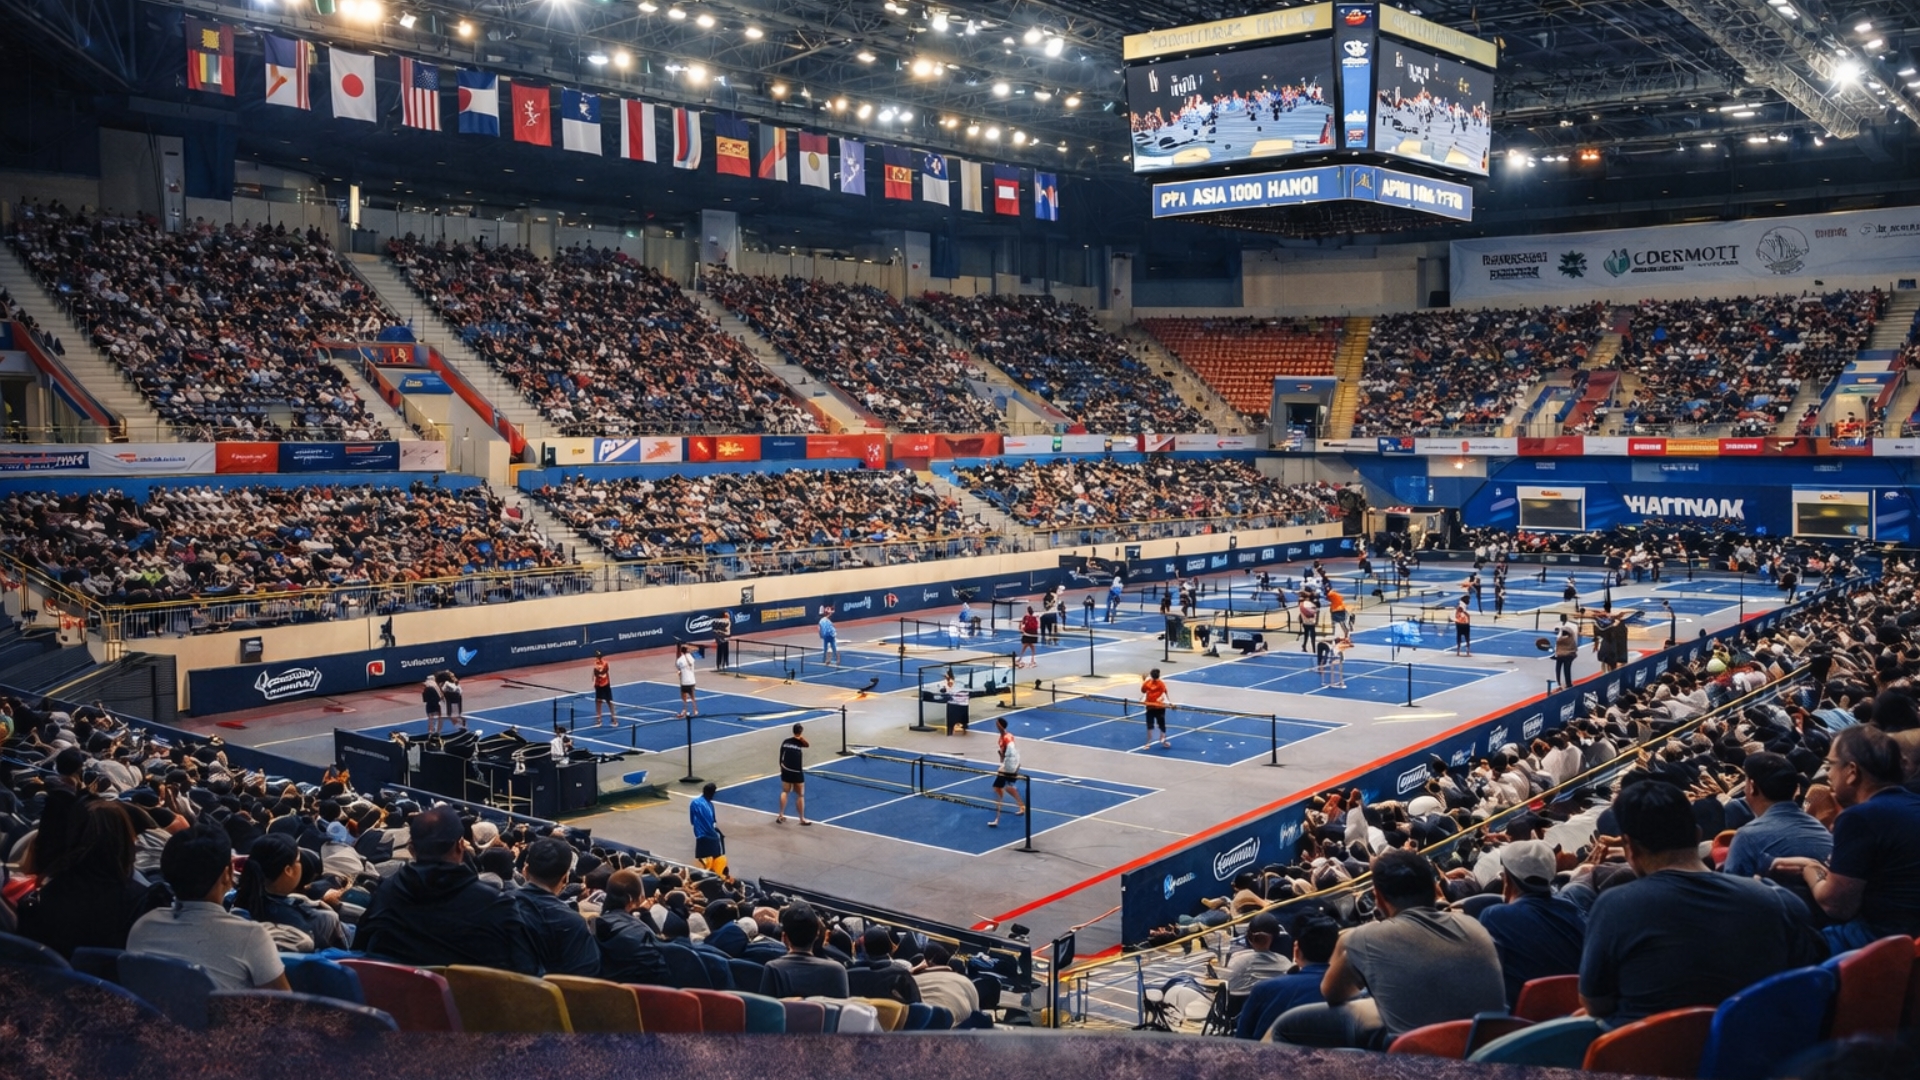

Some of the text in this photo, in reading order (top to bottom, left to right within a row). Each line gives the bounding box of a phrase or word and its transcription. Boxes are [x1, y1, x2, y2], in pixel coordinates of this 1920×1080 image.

[1192, 186, 1227, 206] ASIA
[1230, 182, 1262, 202] 1000
[1268, 176, 1319, 199] HANOI
